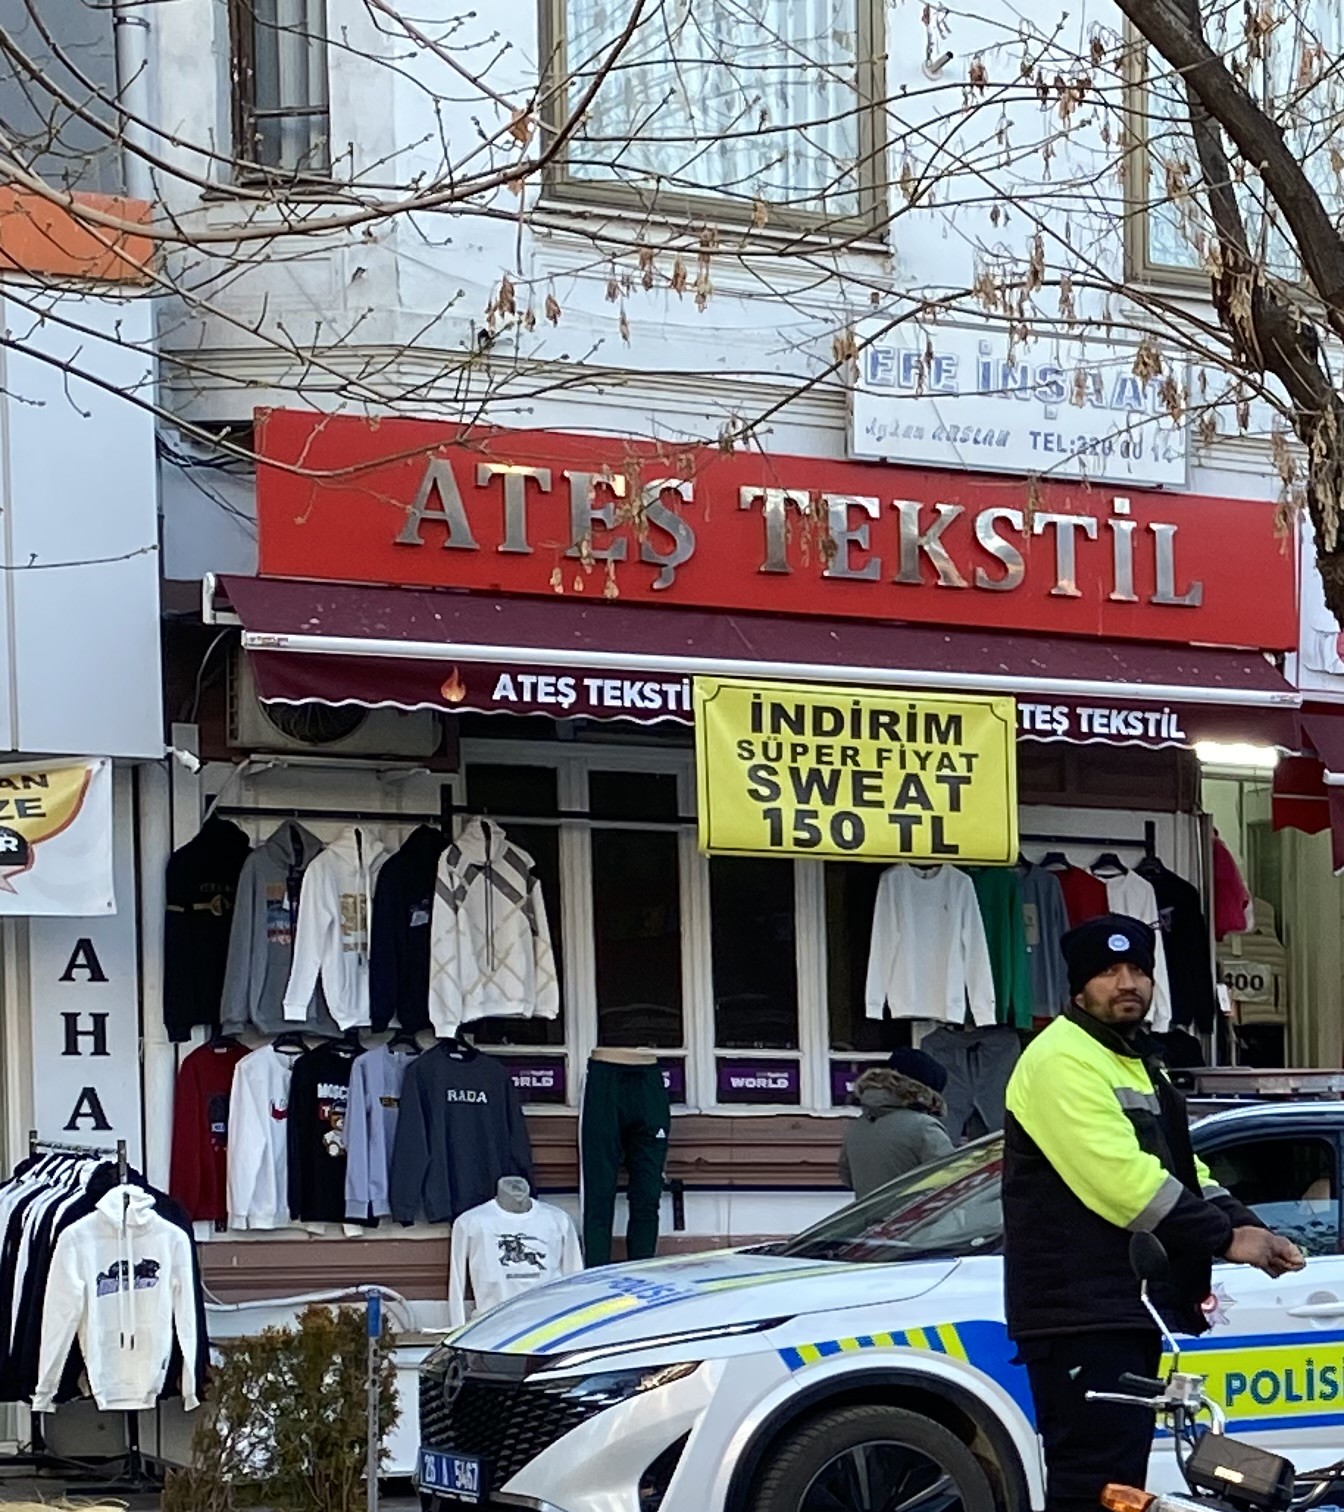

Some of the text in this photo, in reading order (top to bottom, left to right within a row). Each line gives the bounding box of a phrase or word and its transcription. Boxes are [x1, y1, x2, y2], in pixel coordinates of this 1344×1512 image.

[866, 346, 959, 394] EFE
[394, 459, 1204, 607] ATEŞ TEKSTİL
[492, 673, 691, 711] ATEŞ TEKSTİ
[750, 695, 963, 746] İNDİRİM
[1017, 703, 1186, 739] TEŞ TEKSTİL
[737, 736, 978, 774] SÜPER FİYAT
[747, 765, 972, 813] SWEAT
[762, 809, 960, 856] 150 TL
[730, 1076, 789, 1089] WORLD
